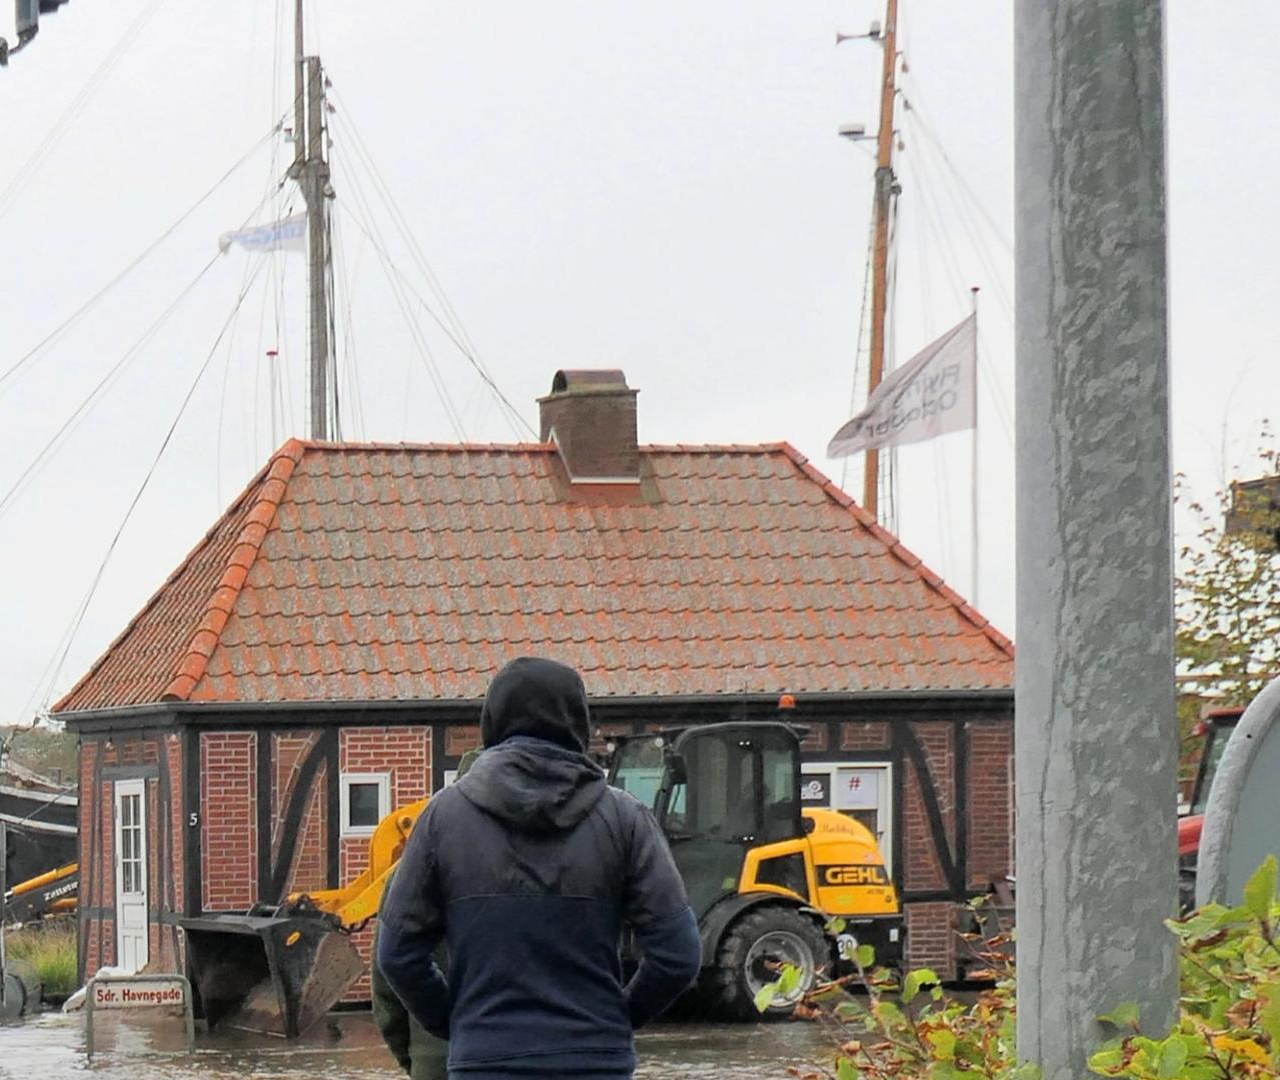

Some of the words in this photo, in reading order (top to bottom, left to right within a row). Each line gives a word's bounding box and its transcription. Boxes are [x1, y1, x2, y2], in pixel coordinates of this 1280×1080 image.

[189, 812, 198, 827] 5
[825, 866, 885, 884] GEHL
[96, 988, 119, 1002] Sdr.
[122, 987, 181, 1004] Havnegade
